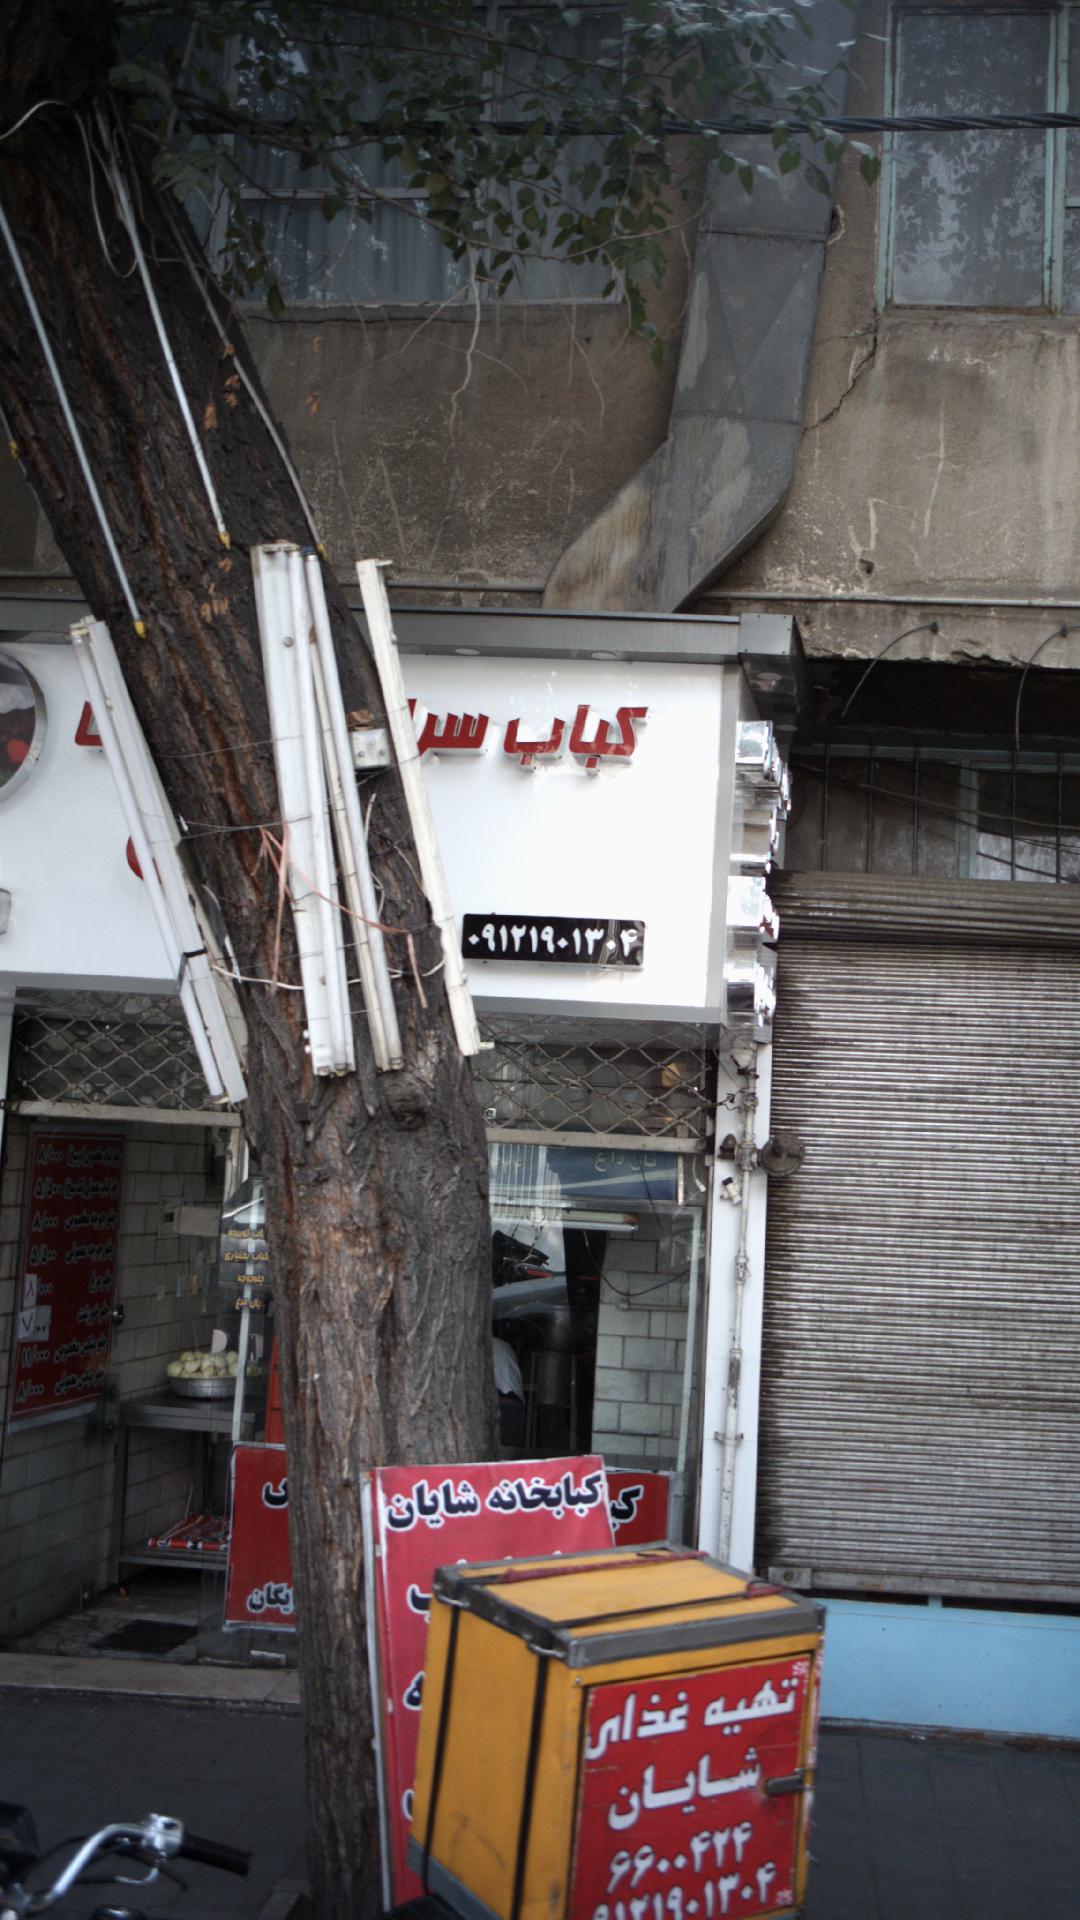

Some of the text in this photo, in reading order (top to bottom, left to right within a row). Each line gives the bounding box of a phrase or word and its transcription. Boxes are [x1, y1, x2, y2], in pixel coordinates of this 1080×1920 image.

[407, 698, 648, 768] کباب سر
[468, 923, 638, 957] ۰۹۱۲۱۹۰۱۳۰۴
[387, 1480, 479, 1529] شایان
[488, 1470, 603, 1518] کبابخانه
[585, 1678, 799, 1760] تهیه غذای
[608, 1747, 761, 1831] شایان
[606, 1822, 752, 1894] ۶۶۰۰۴۲۴
